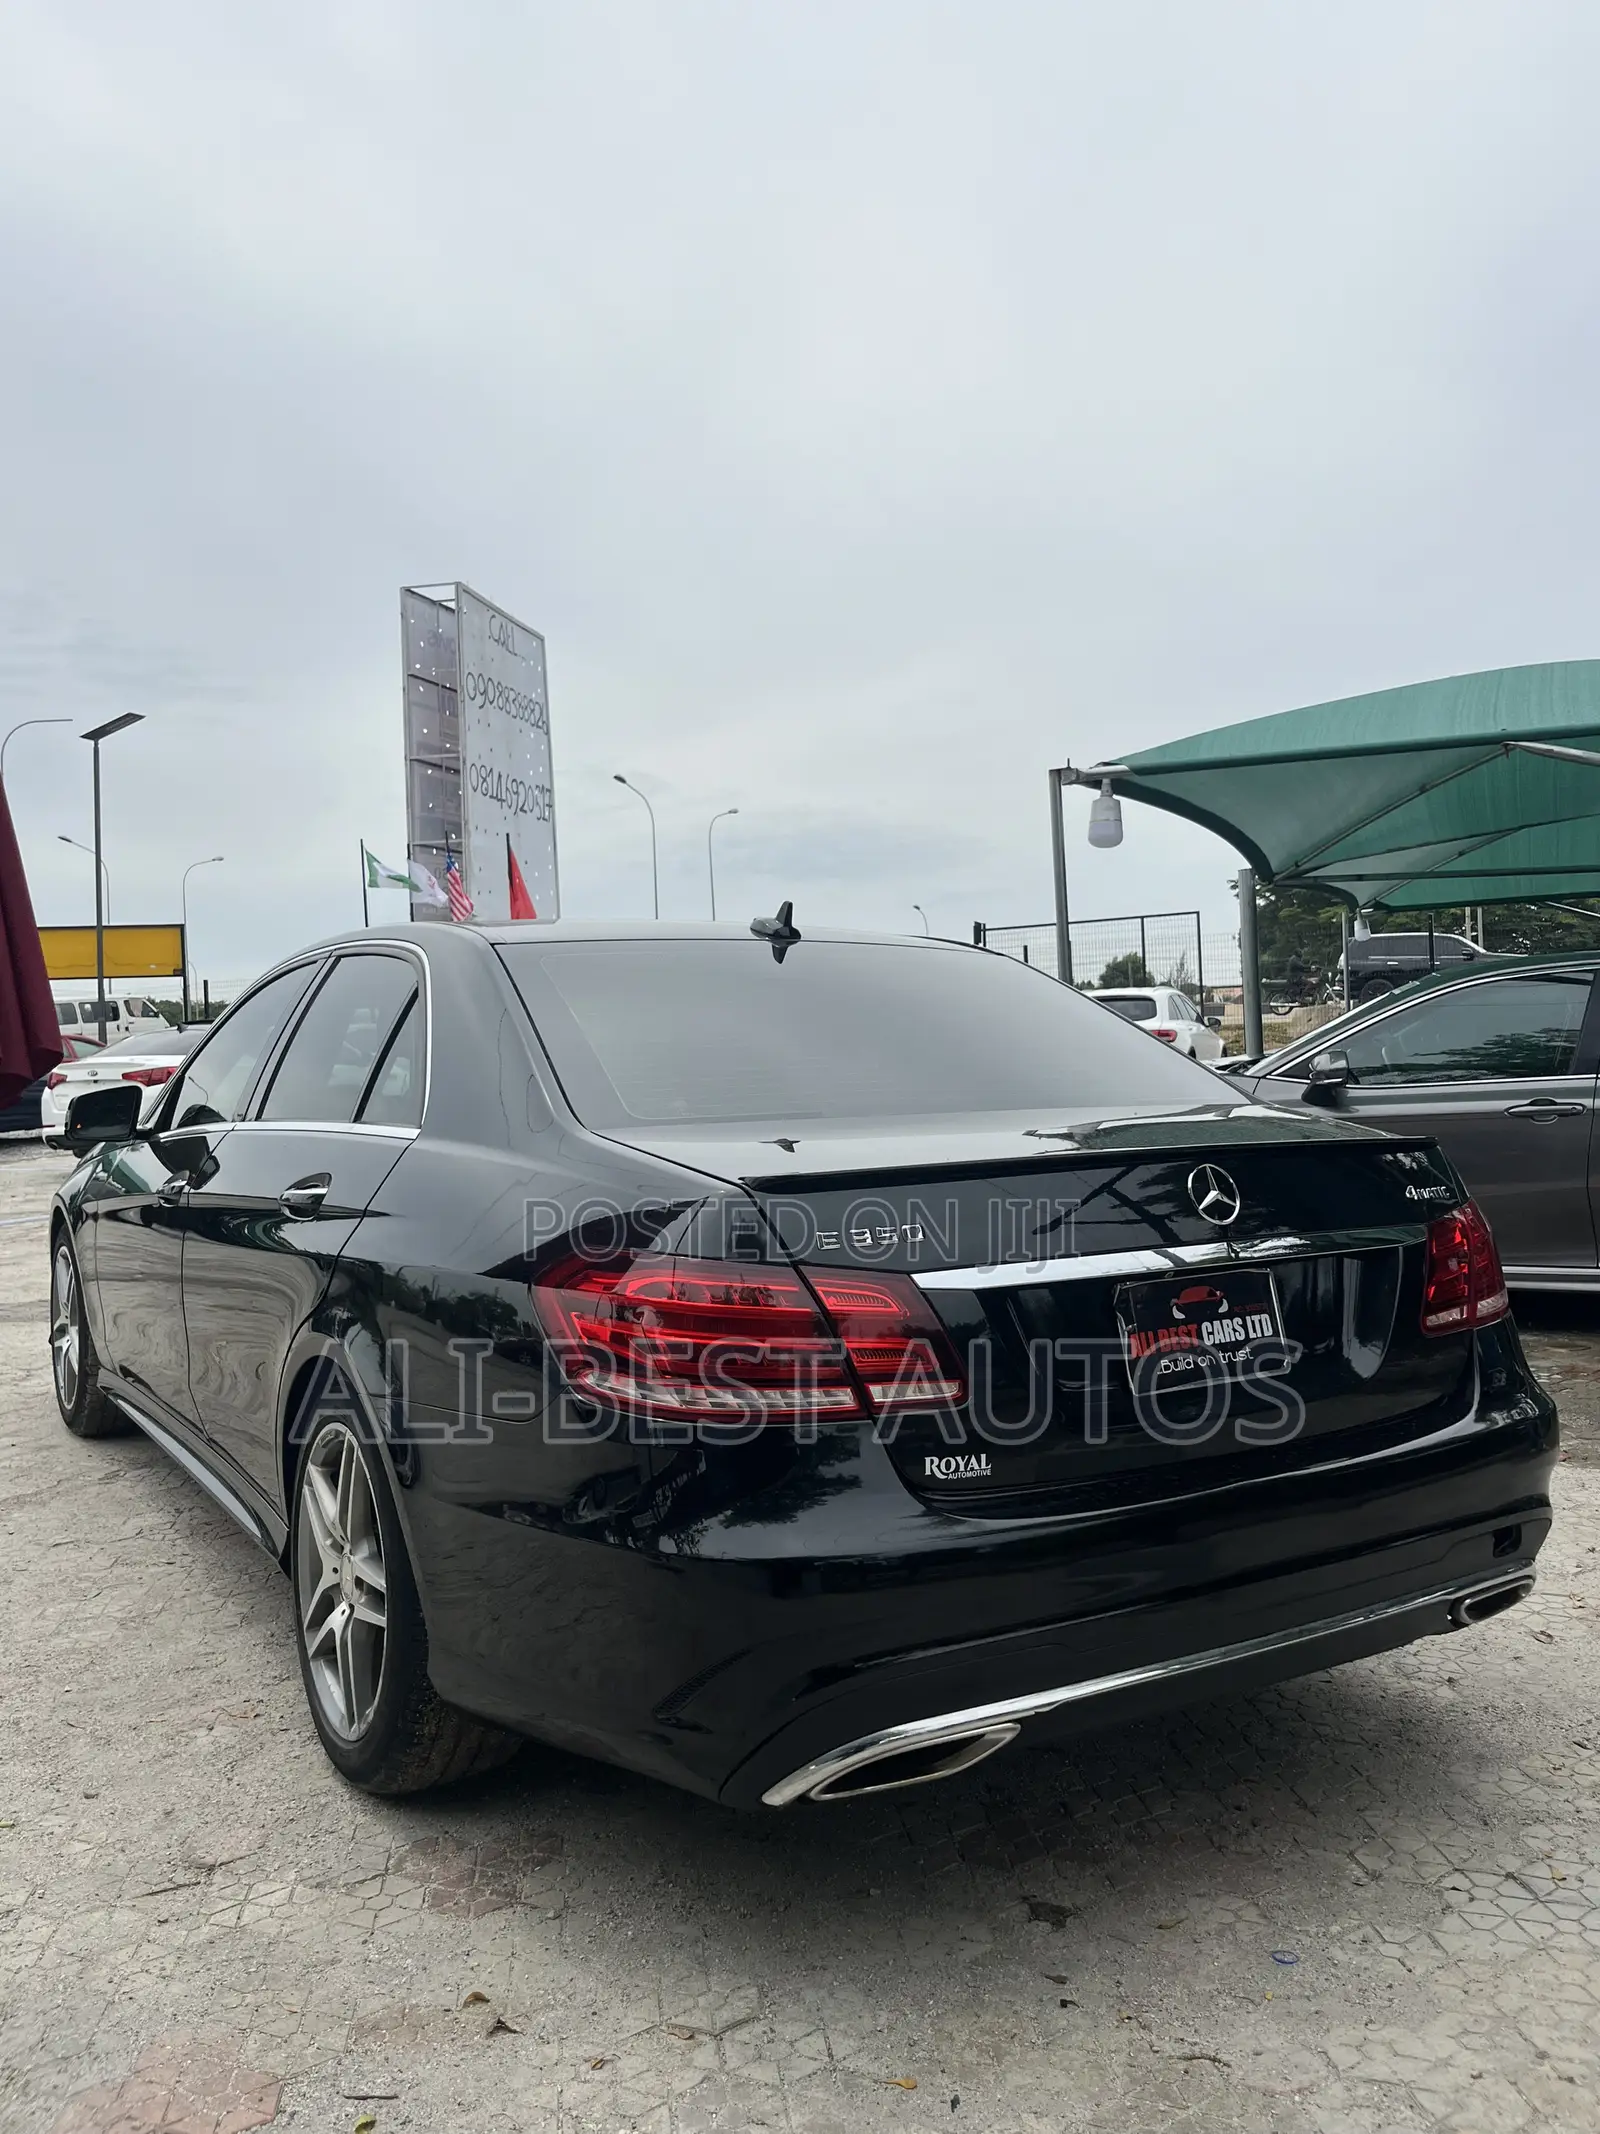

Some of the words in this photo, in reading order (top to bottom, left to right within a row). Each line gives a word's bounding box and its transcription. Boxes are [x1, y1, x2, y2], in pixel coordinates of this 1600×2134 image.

[1405, 1185, 1450, 1200] 4MATIC
[816, 1231, 841, 1250] E
[849, 1224, 925, 1247] 350
[1201, 1317, 1246, 1346] CARS
[1245, 1313, 1273, 1339] LTD
[1197, 1354, 1216, 1368] on
[1218, 1345, 1255, 1364] trust
[924, 1453, 992, 1479] ROYAL
[947, 1468, 992, 1480] AUTOMOTIVE
